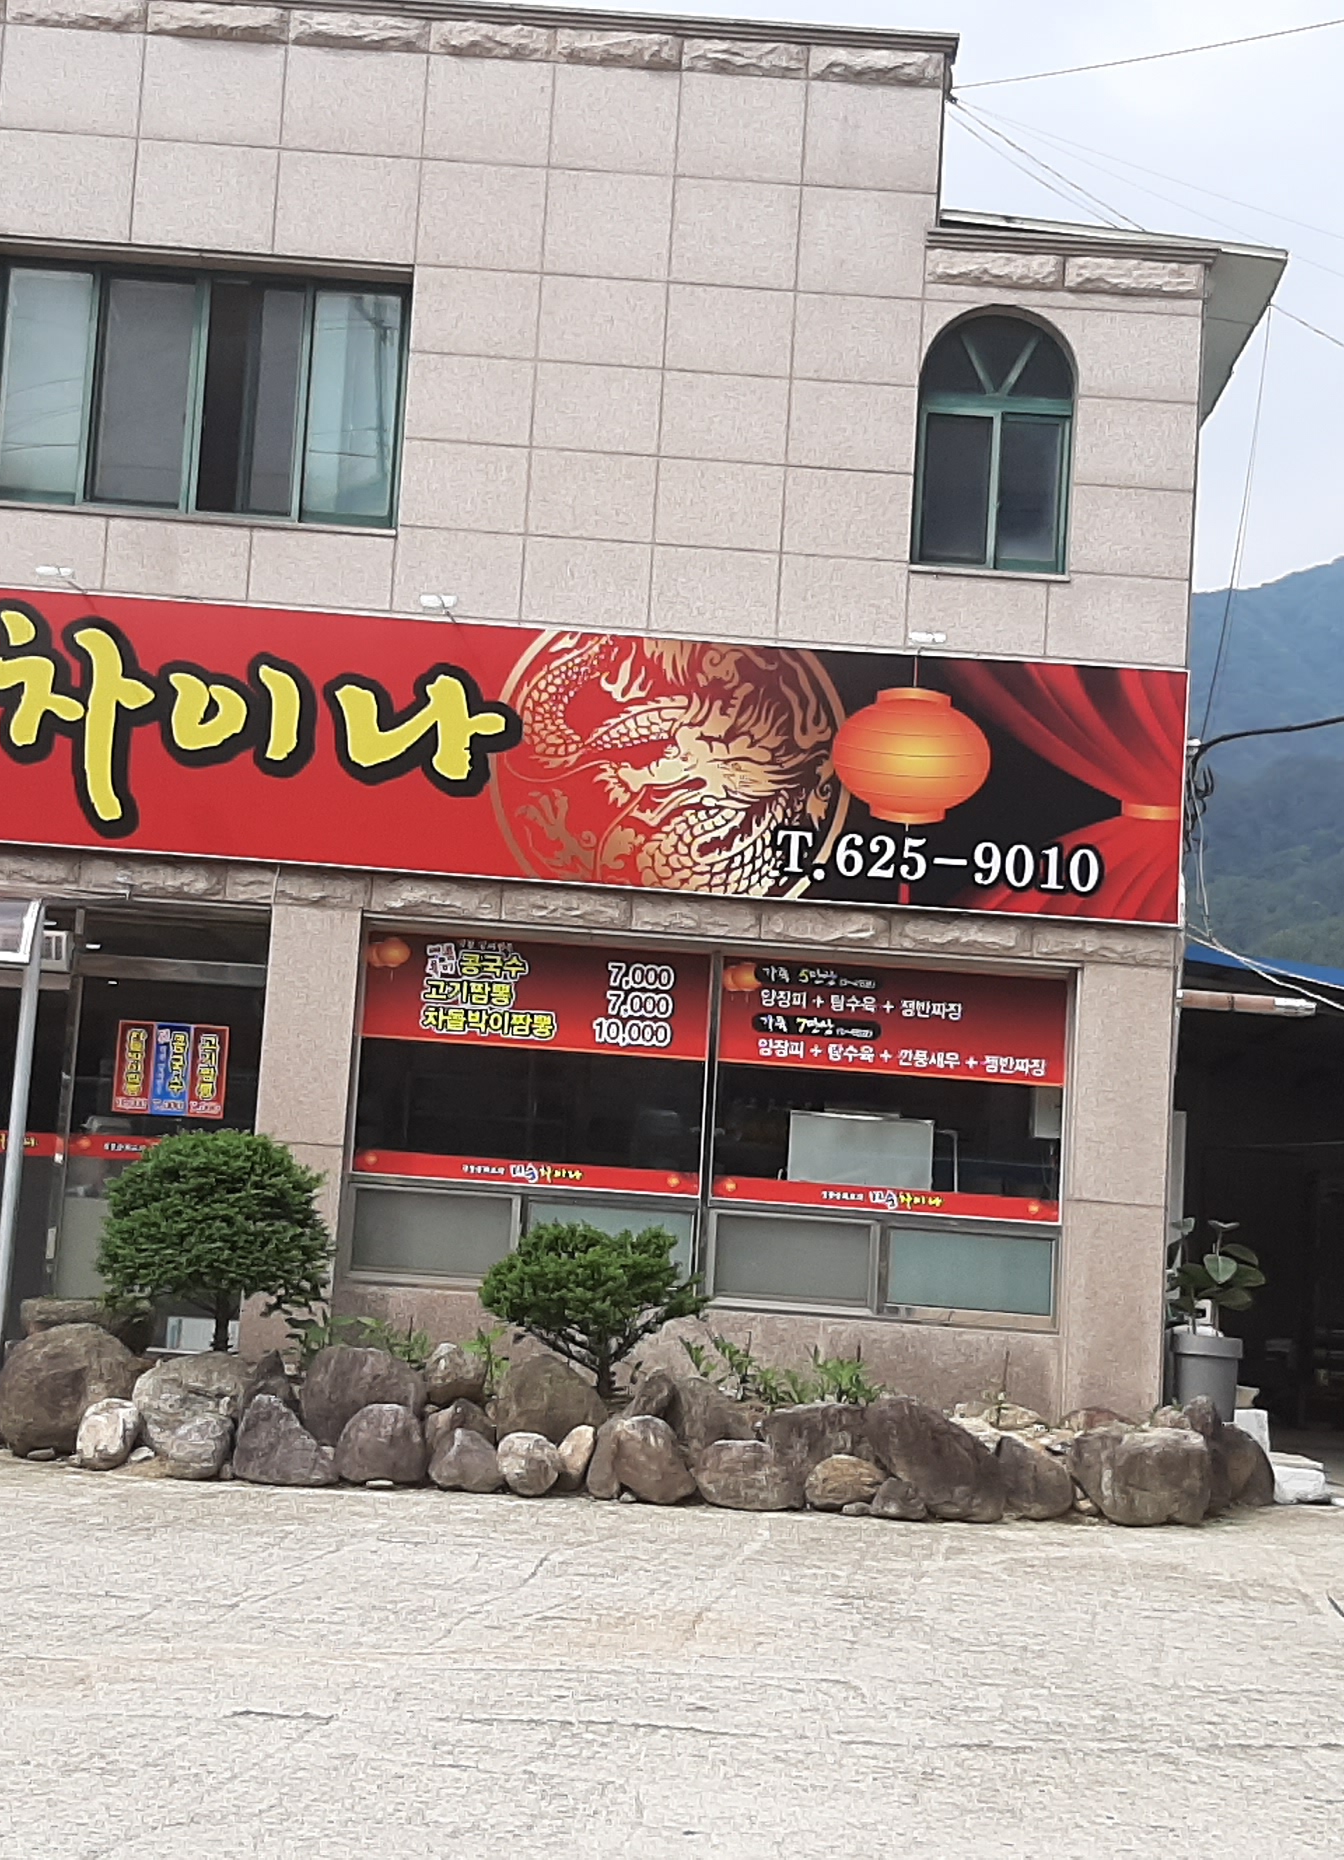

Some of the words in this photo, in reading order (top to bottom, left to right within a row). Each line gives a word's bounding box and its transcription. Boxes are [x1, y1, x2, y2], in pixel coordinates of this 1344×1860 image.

[459, 952, 527, 978] 콩국수
[608, 963, 674, 990] 7,000
[423, 979, 513, 1006] 고기짬뽕
[606, 991, 673, 1018] 7,000
[830, 993, 876, 1014] 탕수육
[422, 1006, 554, 1038] 차돌박이짬뽕
[593, 1017, 672, 1047] 10,000
[828, 1043, 875, 1063] 탕수육
